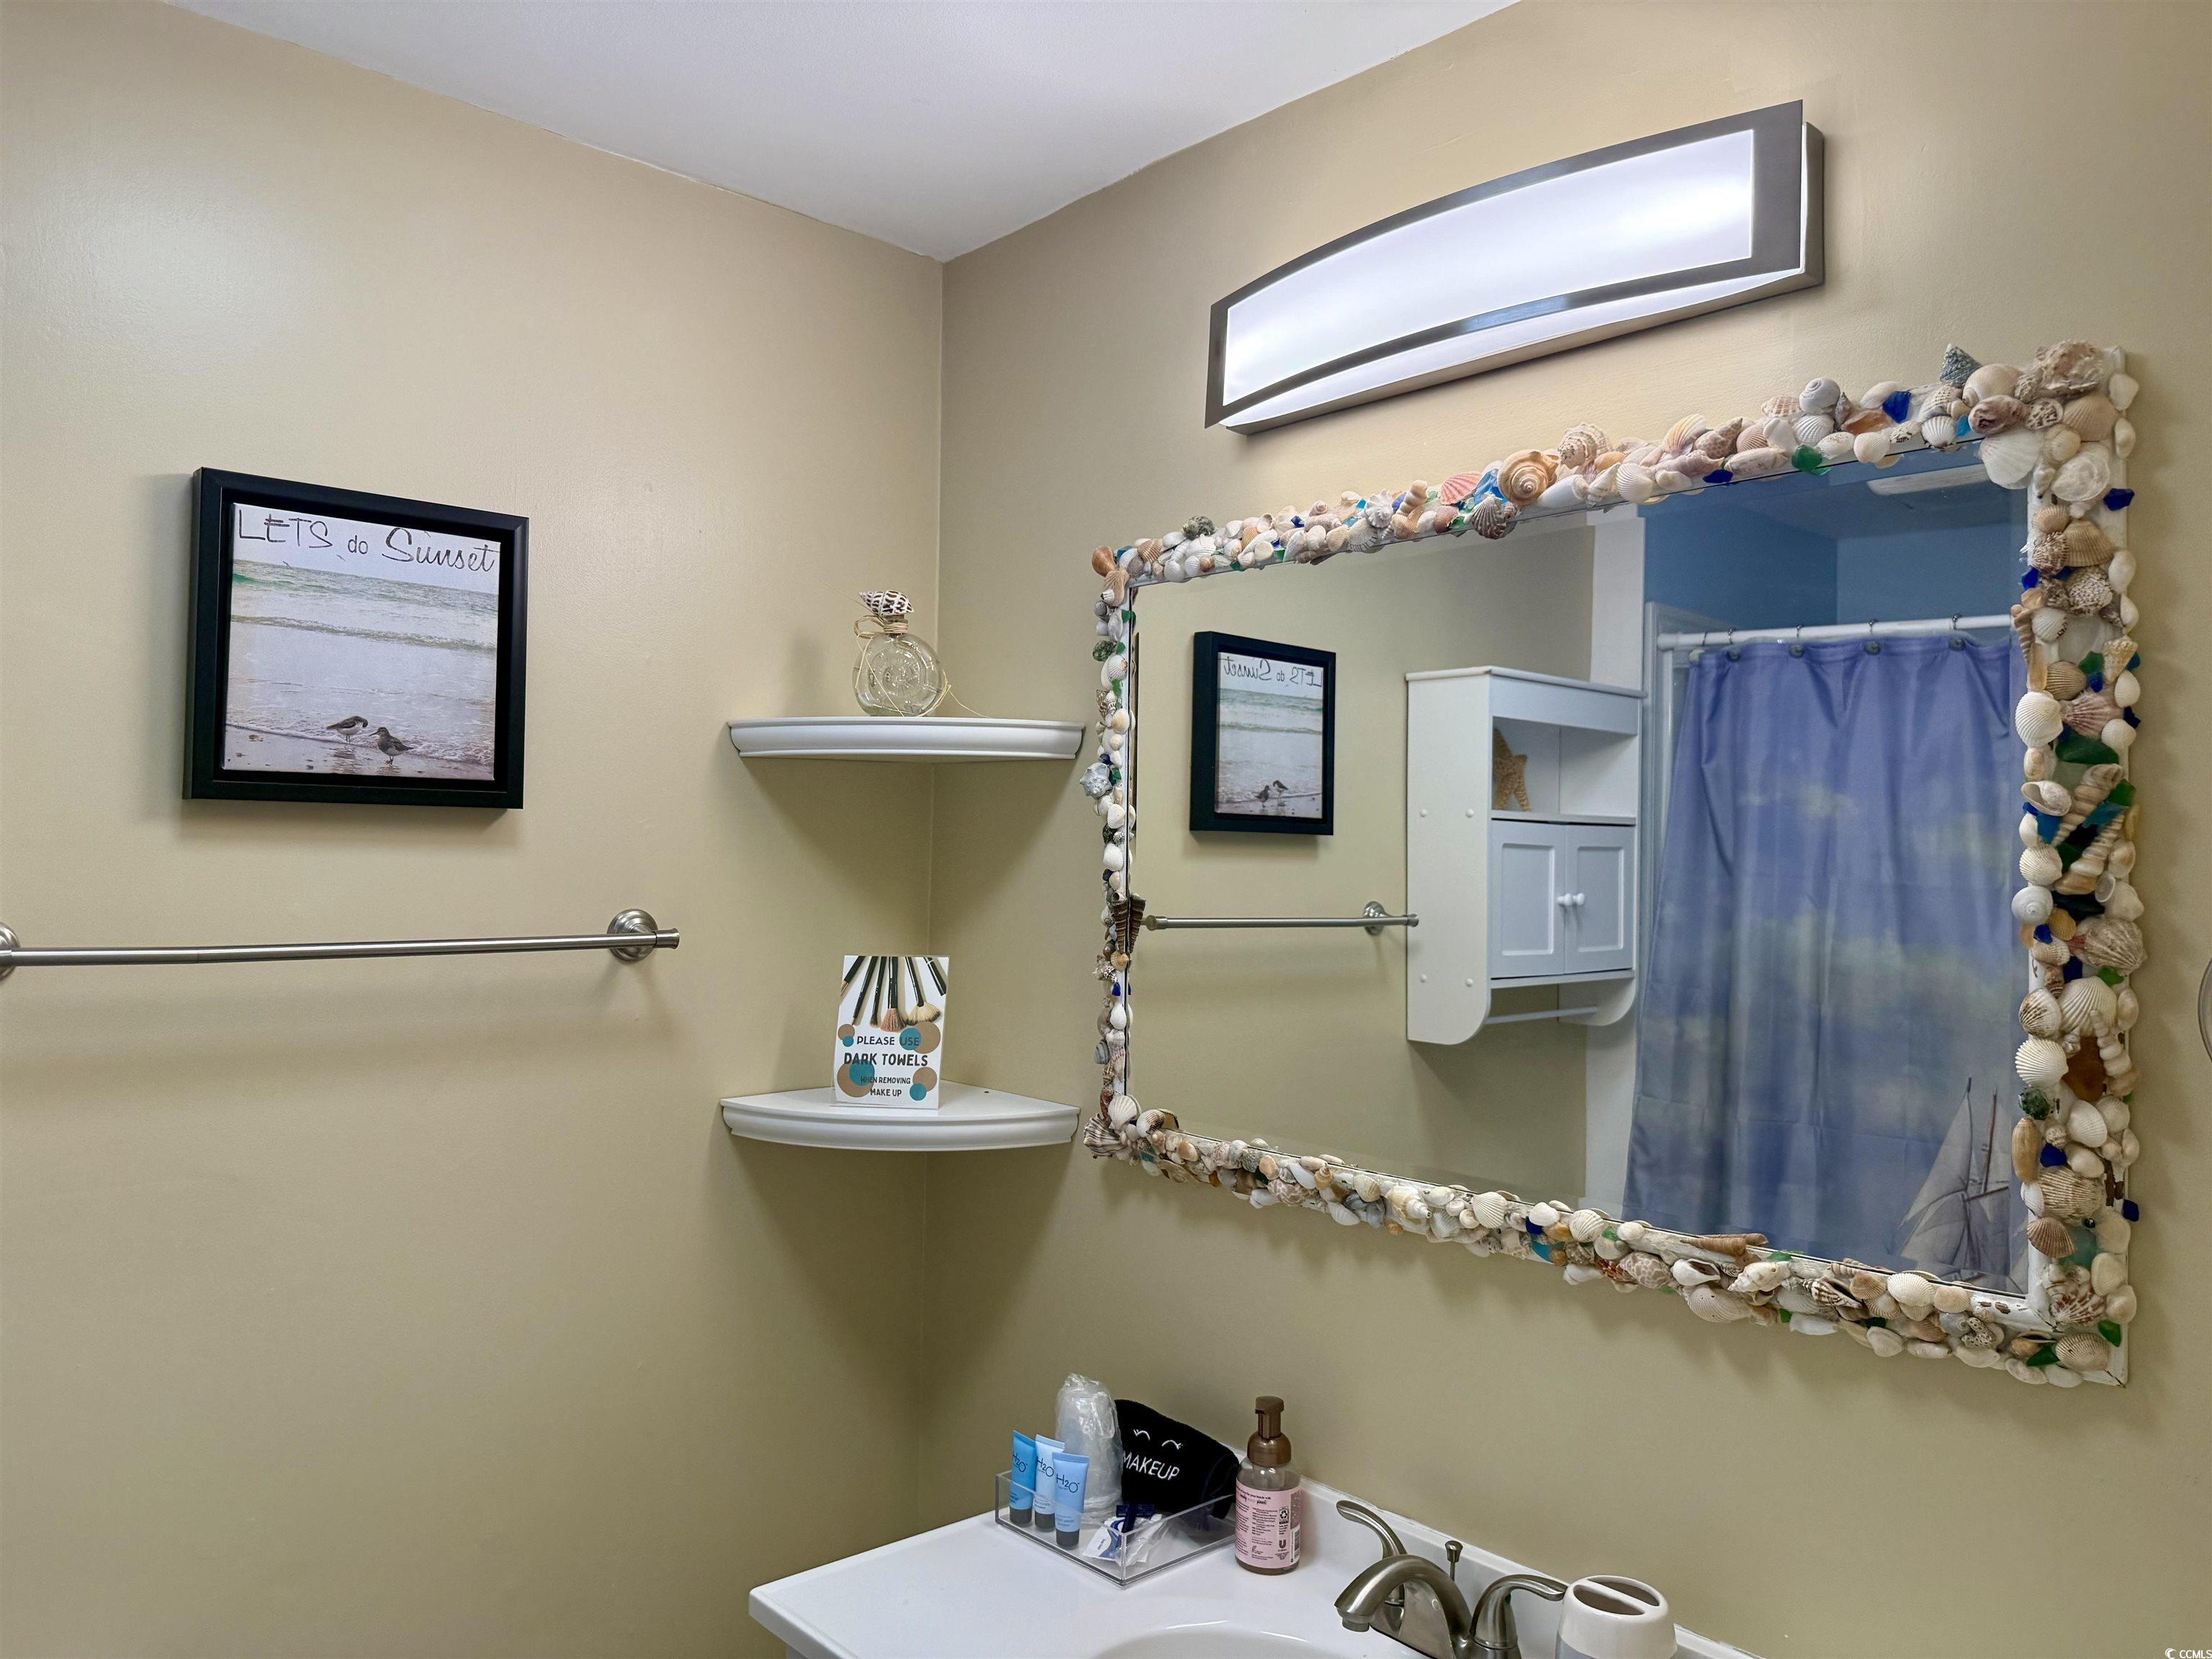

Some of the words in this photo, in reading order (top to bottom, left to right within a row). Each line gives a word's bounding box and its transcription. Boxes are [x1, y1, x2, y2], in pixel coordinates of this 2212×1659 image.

[237, 508, 333, 549] LETS
[347, 534, 369, 555] do
[381, 526, 500, 572] Sunset
[857, 1035, 895, 1046] PLEASE
[900, 1036, 920, 1046] USE
[843, 1052, 878, 1066] DARK
[881, 1053, 929, 1066] TOWELS
[870, 1088, 891, 1097] MAKE
[891, 1089, 902, 1097] UP
[1123, 1449, 1180, 1481] MAKEUP
